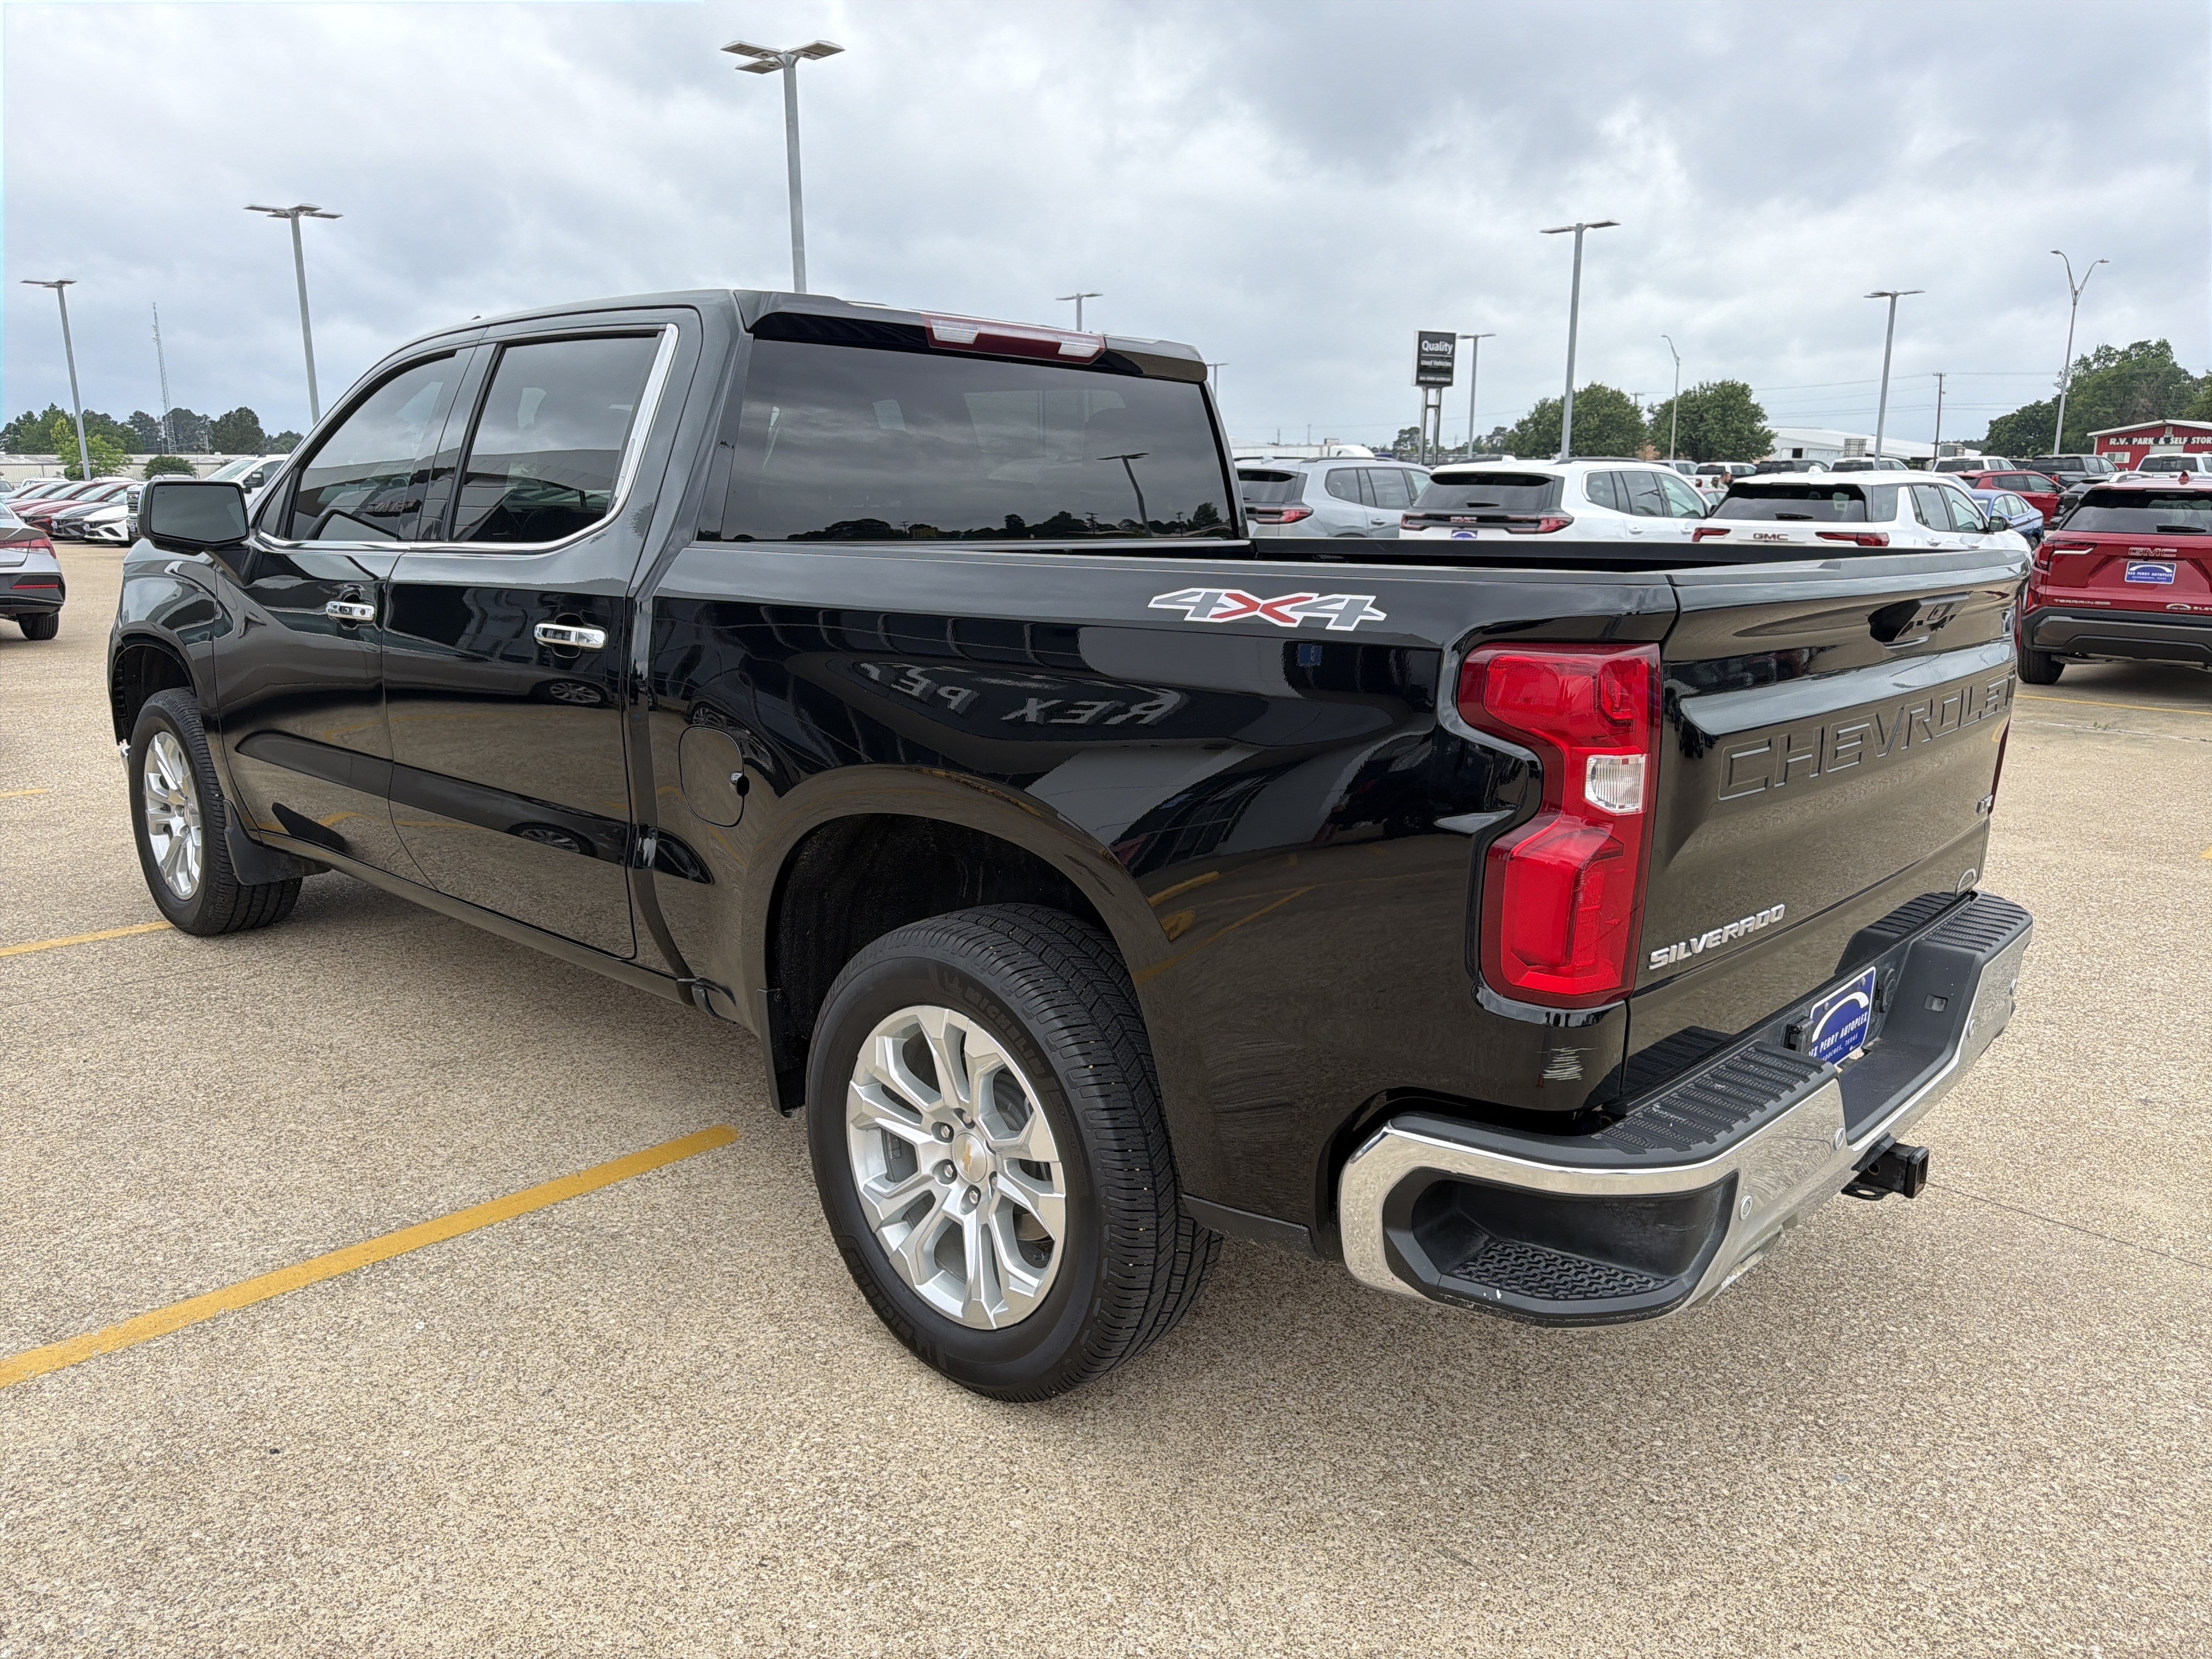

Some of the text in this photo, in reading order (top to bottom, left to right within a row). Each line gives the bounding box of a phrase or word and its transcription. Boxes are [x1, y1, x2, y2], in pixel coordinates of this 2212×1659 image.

[1421, 340, 1453, 355] Quality
[2109, 437, 2129, 445] R.V.
[2132, 437, 2154, 445] PARK
[2158, 437, 2165, 445] &
[2169, 437, 2188, 445] SELF
[1753, 533, 1789, 541] GMC
[2128, 547, 2177, 557] GMC
[1718, 668, 2016, 800] CHEVROLET
[1647, 902, 1786, 971] SILVERADO
[964, 987, 1046, 1075] MICHELIN
[1819, 1031, 1839, 1053] PERRY
[1839, 1011, 1868, 1039] AUTOPLEX
[1844, 1032, 1859, 1047] TEXAS
